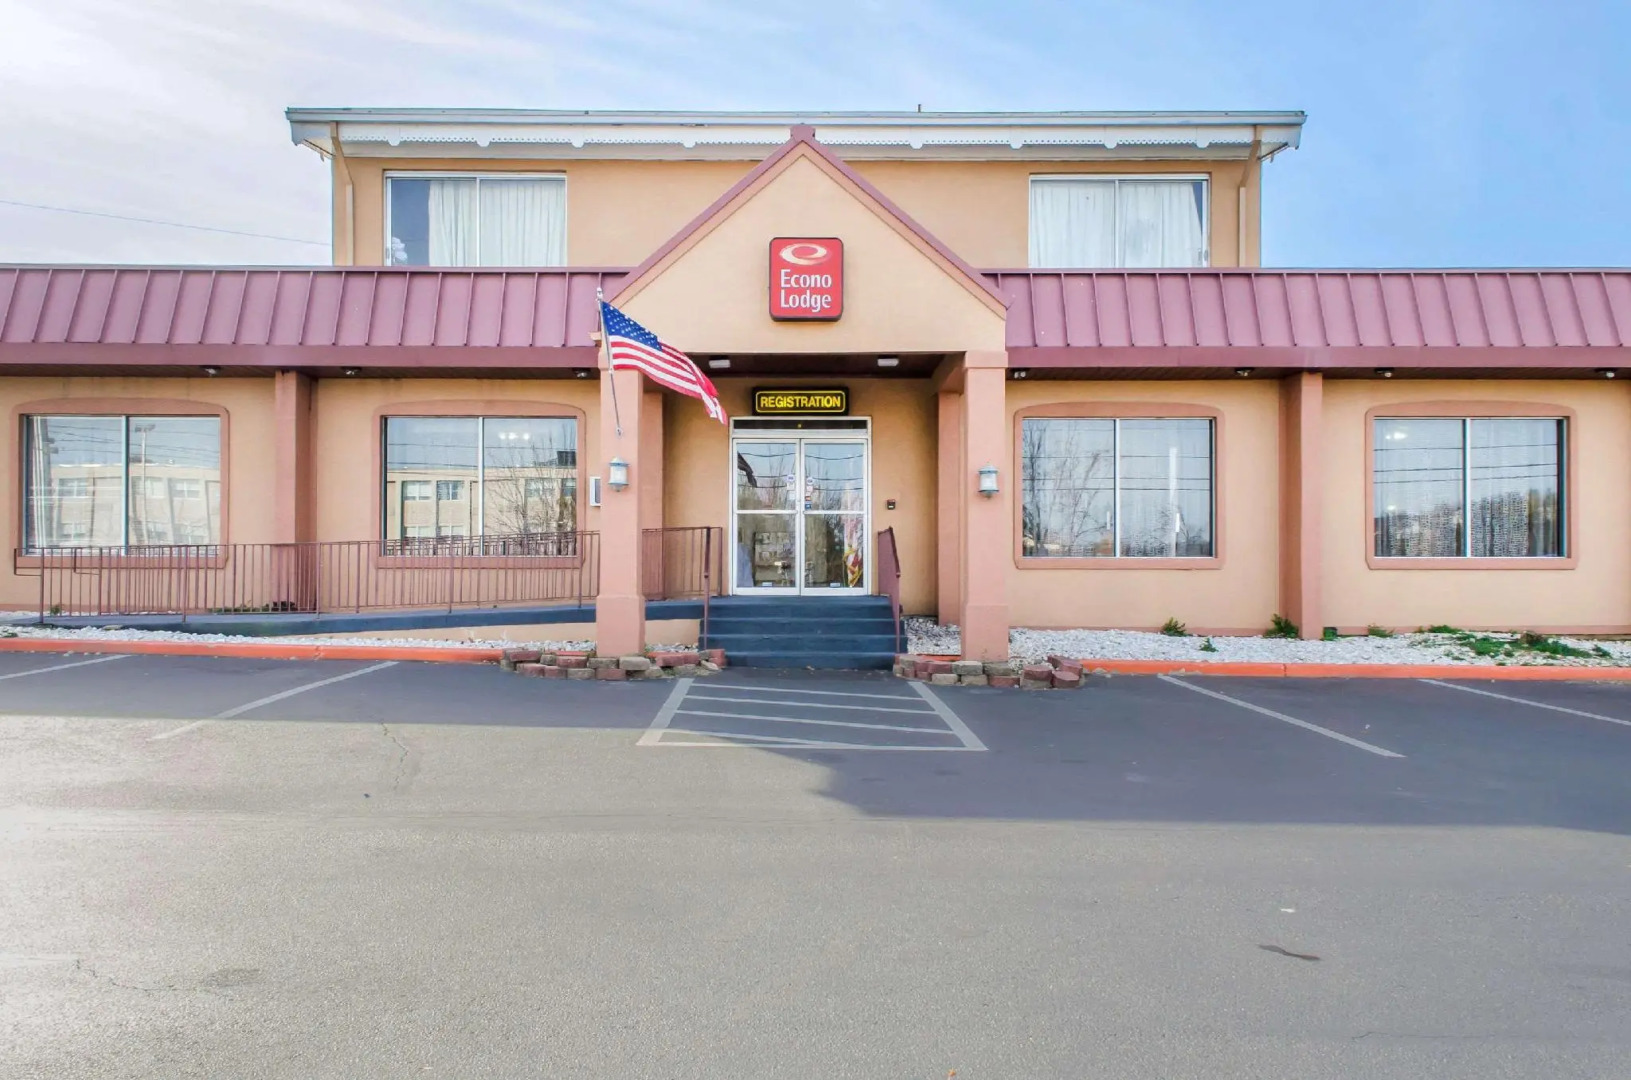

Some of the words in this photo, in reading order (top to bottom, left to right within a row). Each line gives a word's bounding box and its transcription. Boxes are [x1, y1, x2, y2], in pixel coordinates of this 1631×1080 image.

[780, 269, 832, 288] Econo
[780, 290, 831, 312] Lodge
[760, 396, 841, 408] REGISTRATION
